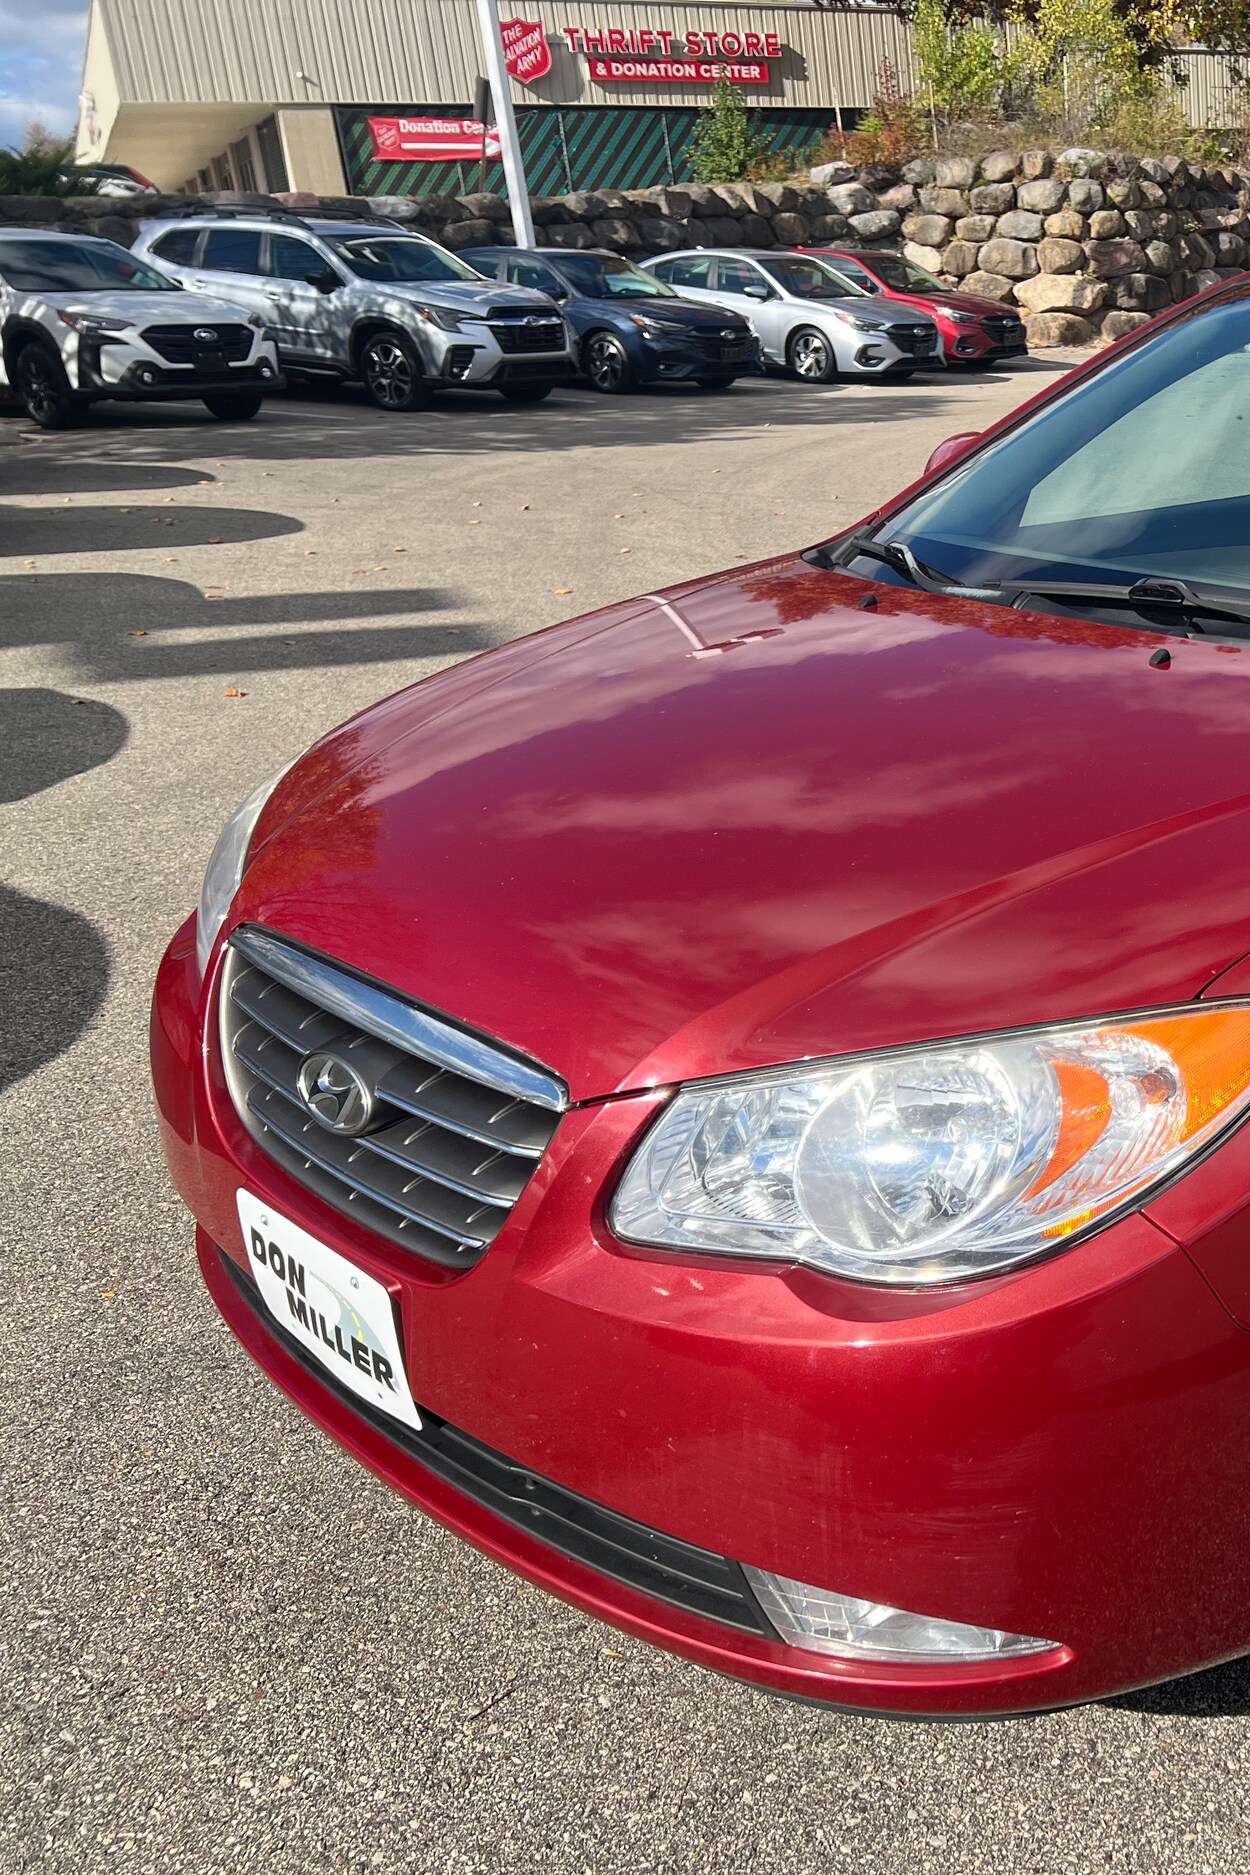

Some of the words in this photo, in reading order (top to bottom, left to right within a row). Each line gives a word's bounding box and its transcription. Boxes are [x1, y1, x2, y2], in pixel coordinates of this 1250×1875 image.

[502, 23, 523, 45] THE
[504, 27, 541, 64] ALVATION
[563, 27, 673, 55] THRIFT
[684, 31, 783, 58] STORE
[516, 45, 542, 75] ARMY
[596, 62, 608, 76] &
[611, 63, 697, 77] DONATION
[700, 64, 761, 79] CENTER
[399, 119, 461, 134] Donation
[250, 1225, 307, 1299] DON
[286, 1287, 398, 1394] MILLER
